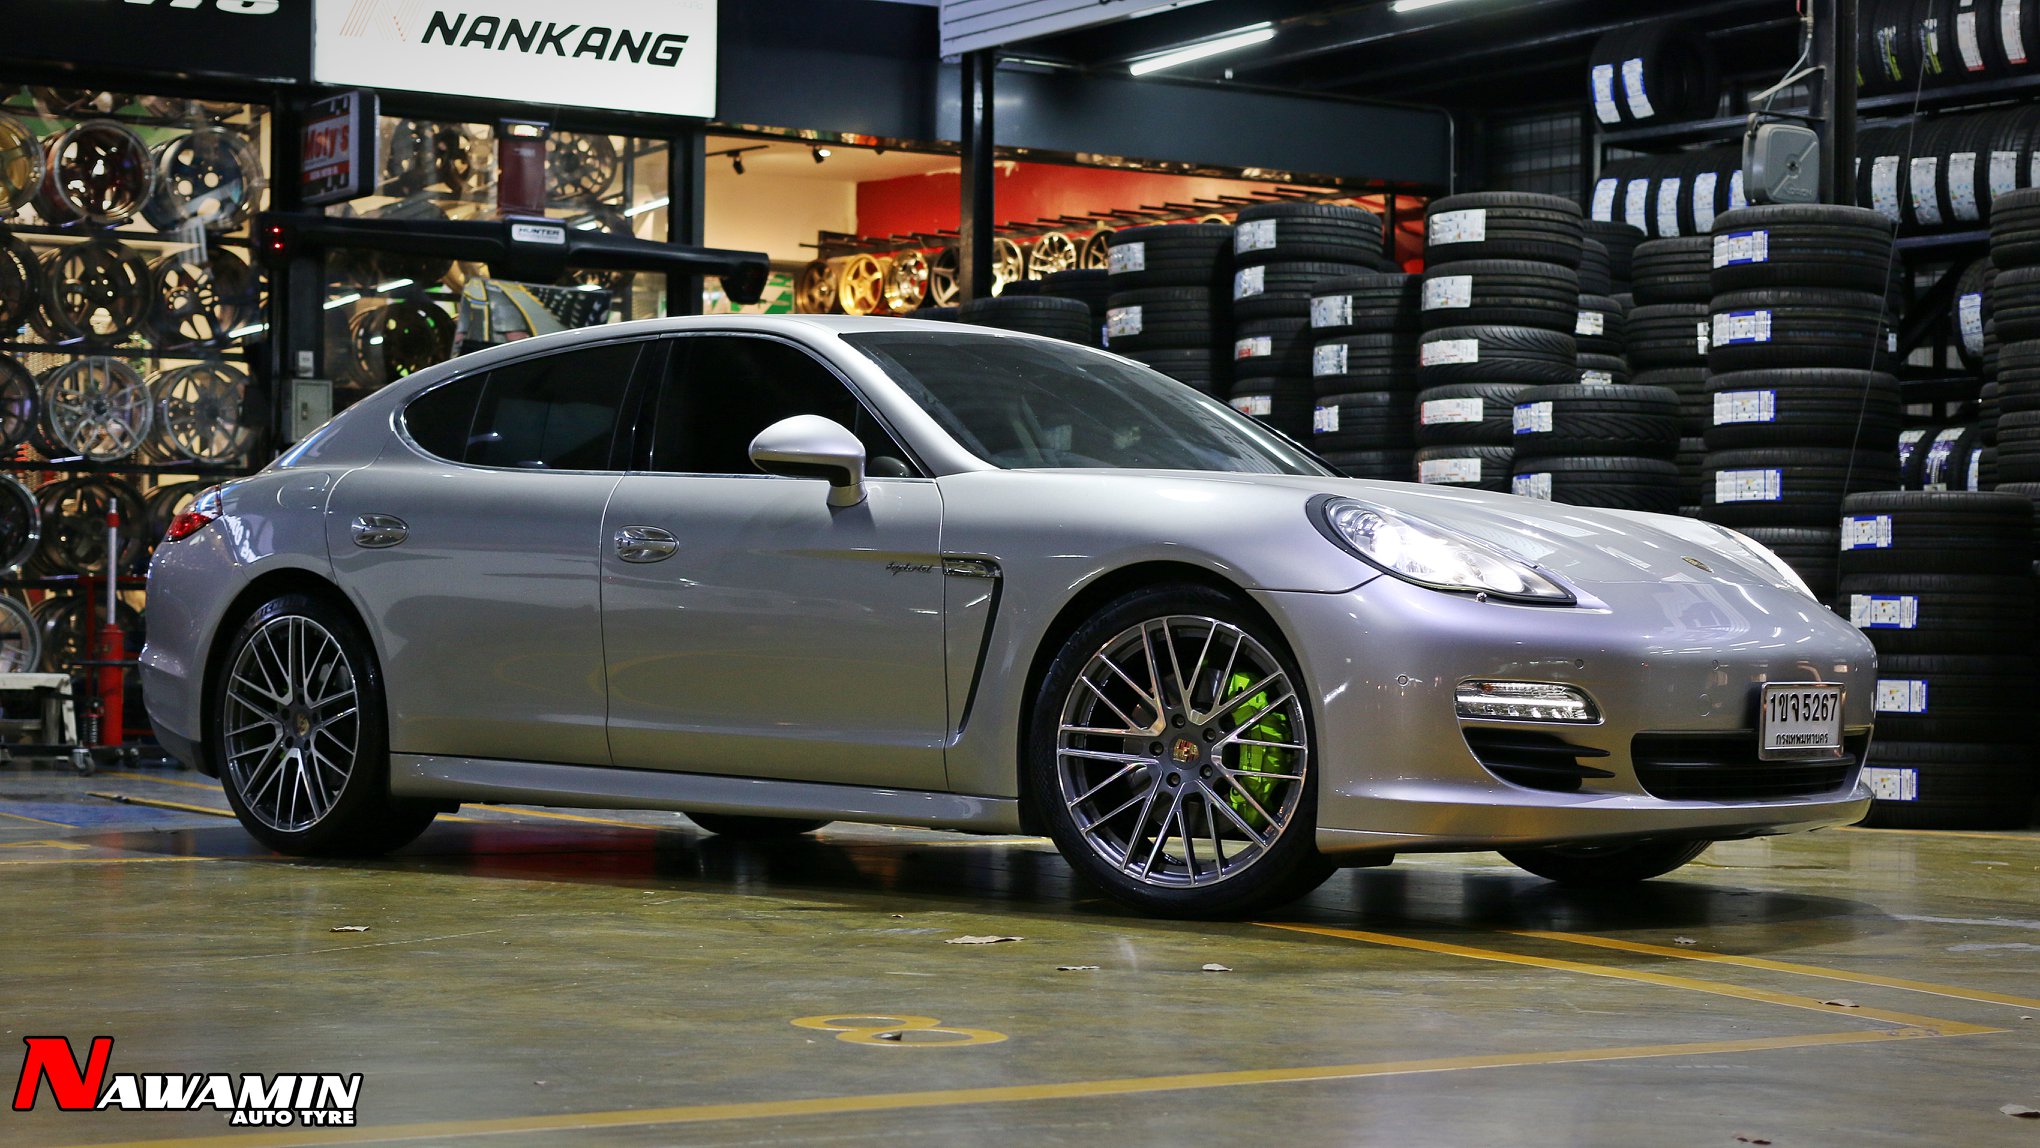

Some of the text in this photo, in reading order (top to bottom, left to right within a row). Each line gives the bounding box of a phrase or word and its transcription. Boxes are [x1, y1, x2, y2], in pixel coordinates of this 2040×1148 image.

[421, 10, 690, 68] NANKANG
[519, 227, 561, 236] HUNTER
[1803, 692, 1838, 722] 5267
[789, 1013, 1009, 1047] 8
